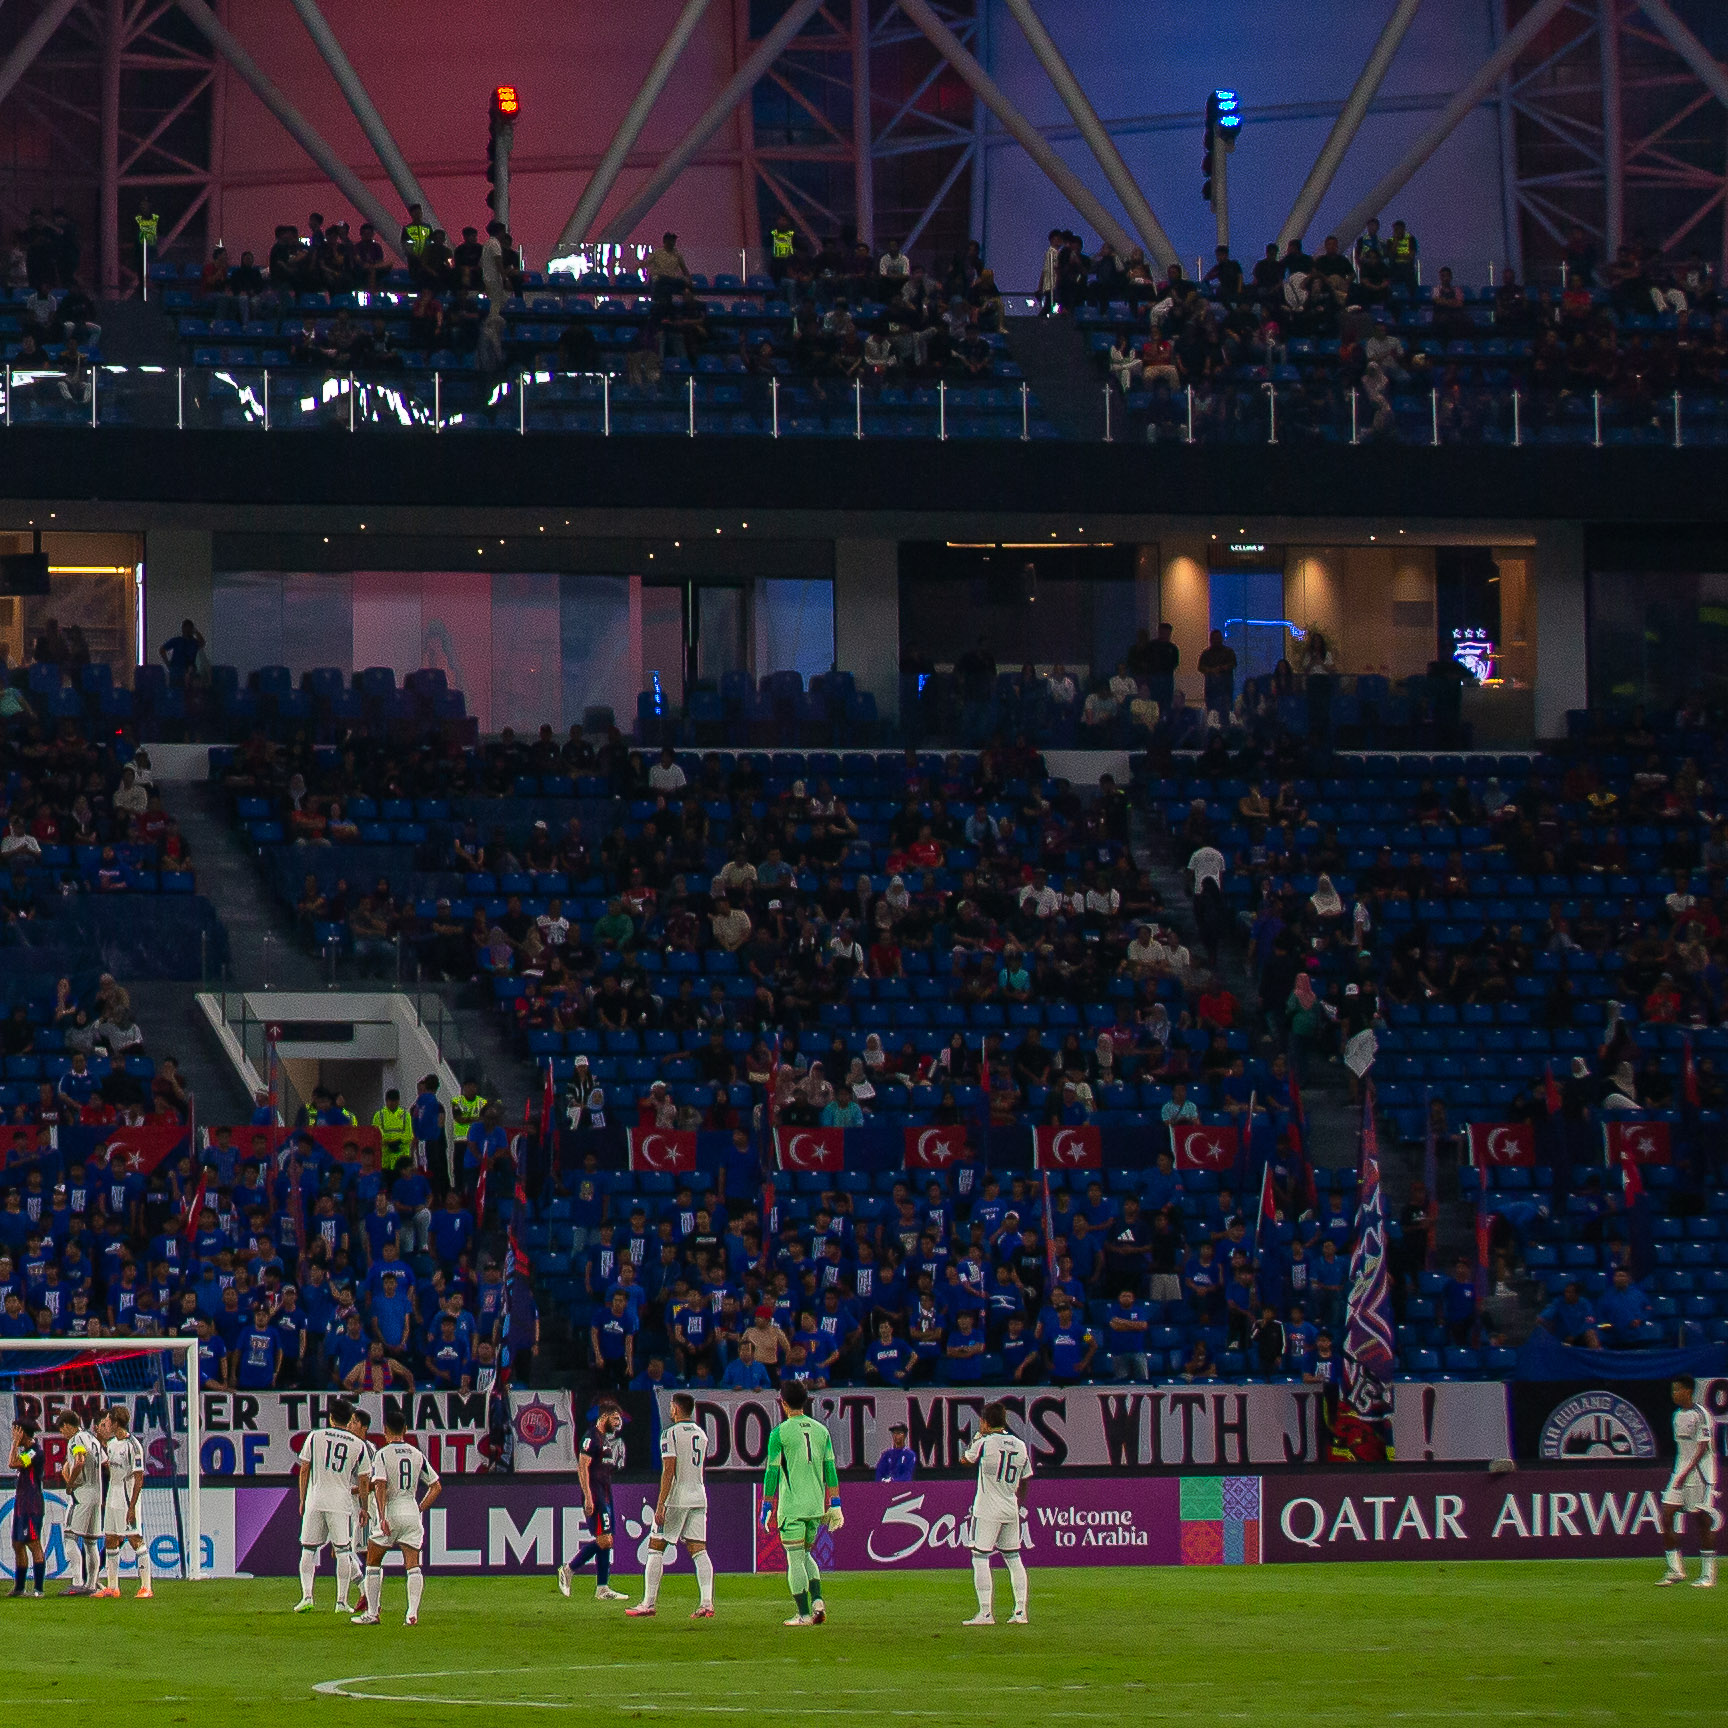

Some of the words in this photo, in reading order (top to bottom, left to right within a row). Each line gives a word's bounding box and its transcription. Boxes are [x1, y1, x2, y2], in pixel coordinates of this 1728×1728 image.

[382, 1393, 490, 1430] NAM
[693, 1395, 877, 1470] DO'T
[1095, 1391, 1250, 1467] WITH
[199, 1433, 271, 1476] OF
[324, 1439, 349, 1473] 19
[690, 1434, 701, 1468] 5
[802, 1431, 812, 1465] 1
[398, 1457, 413, 1491] 8
[995, 1449, 1019, 1484] 16
[1036, 1506, 1134, 1526] Welcome
[1280, 1494, 1471, 1549] QATAR
[1055, 1529, 1077, 1547] to
[1081, 1527, 1150, 1547] Arabia
